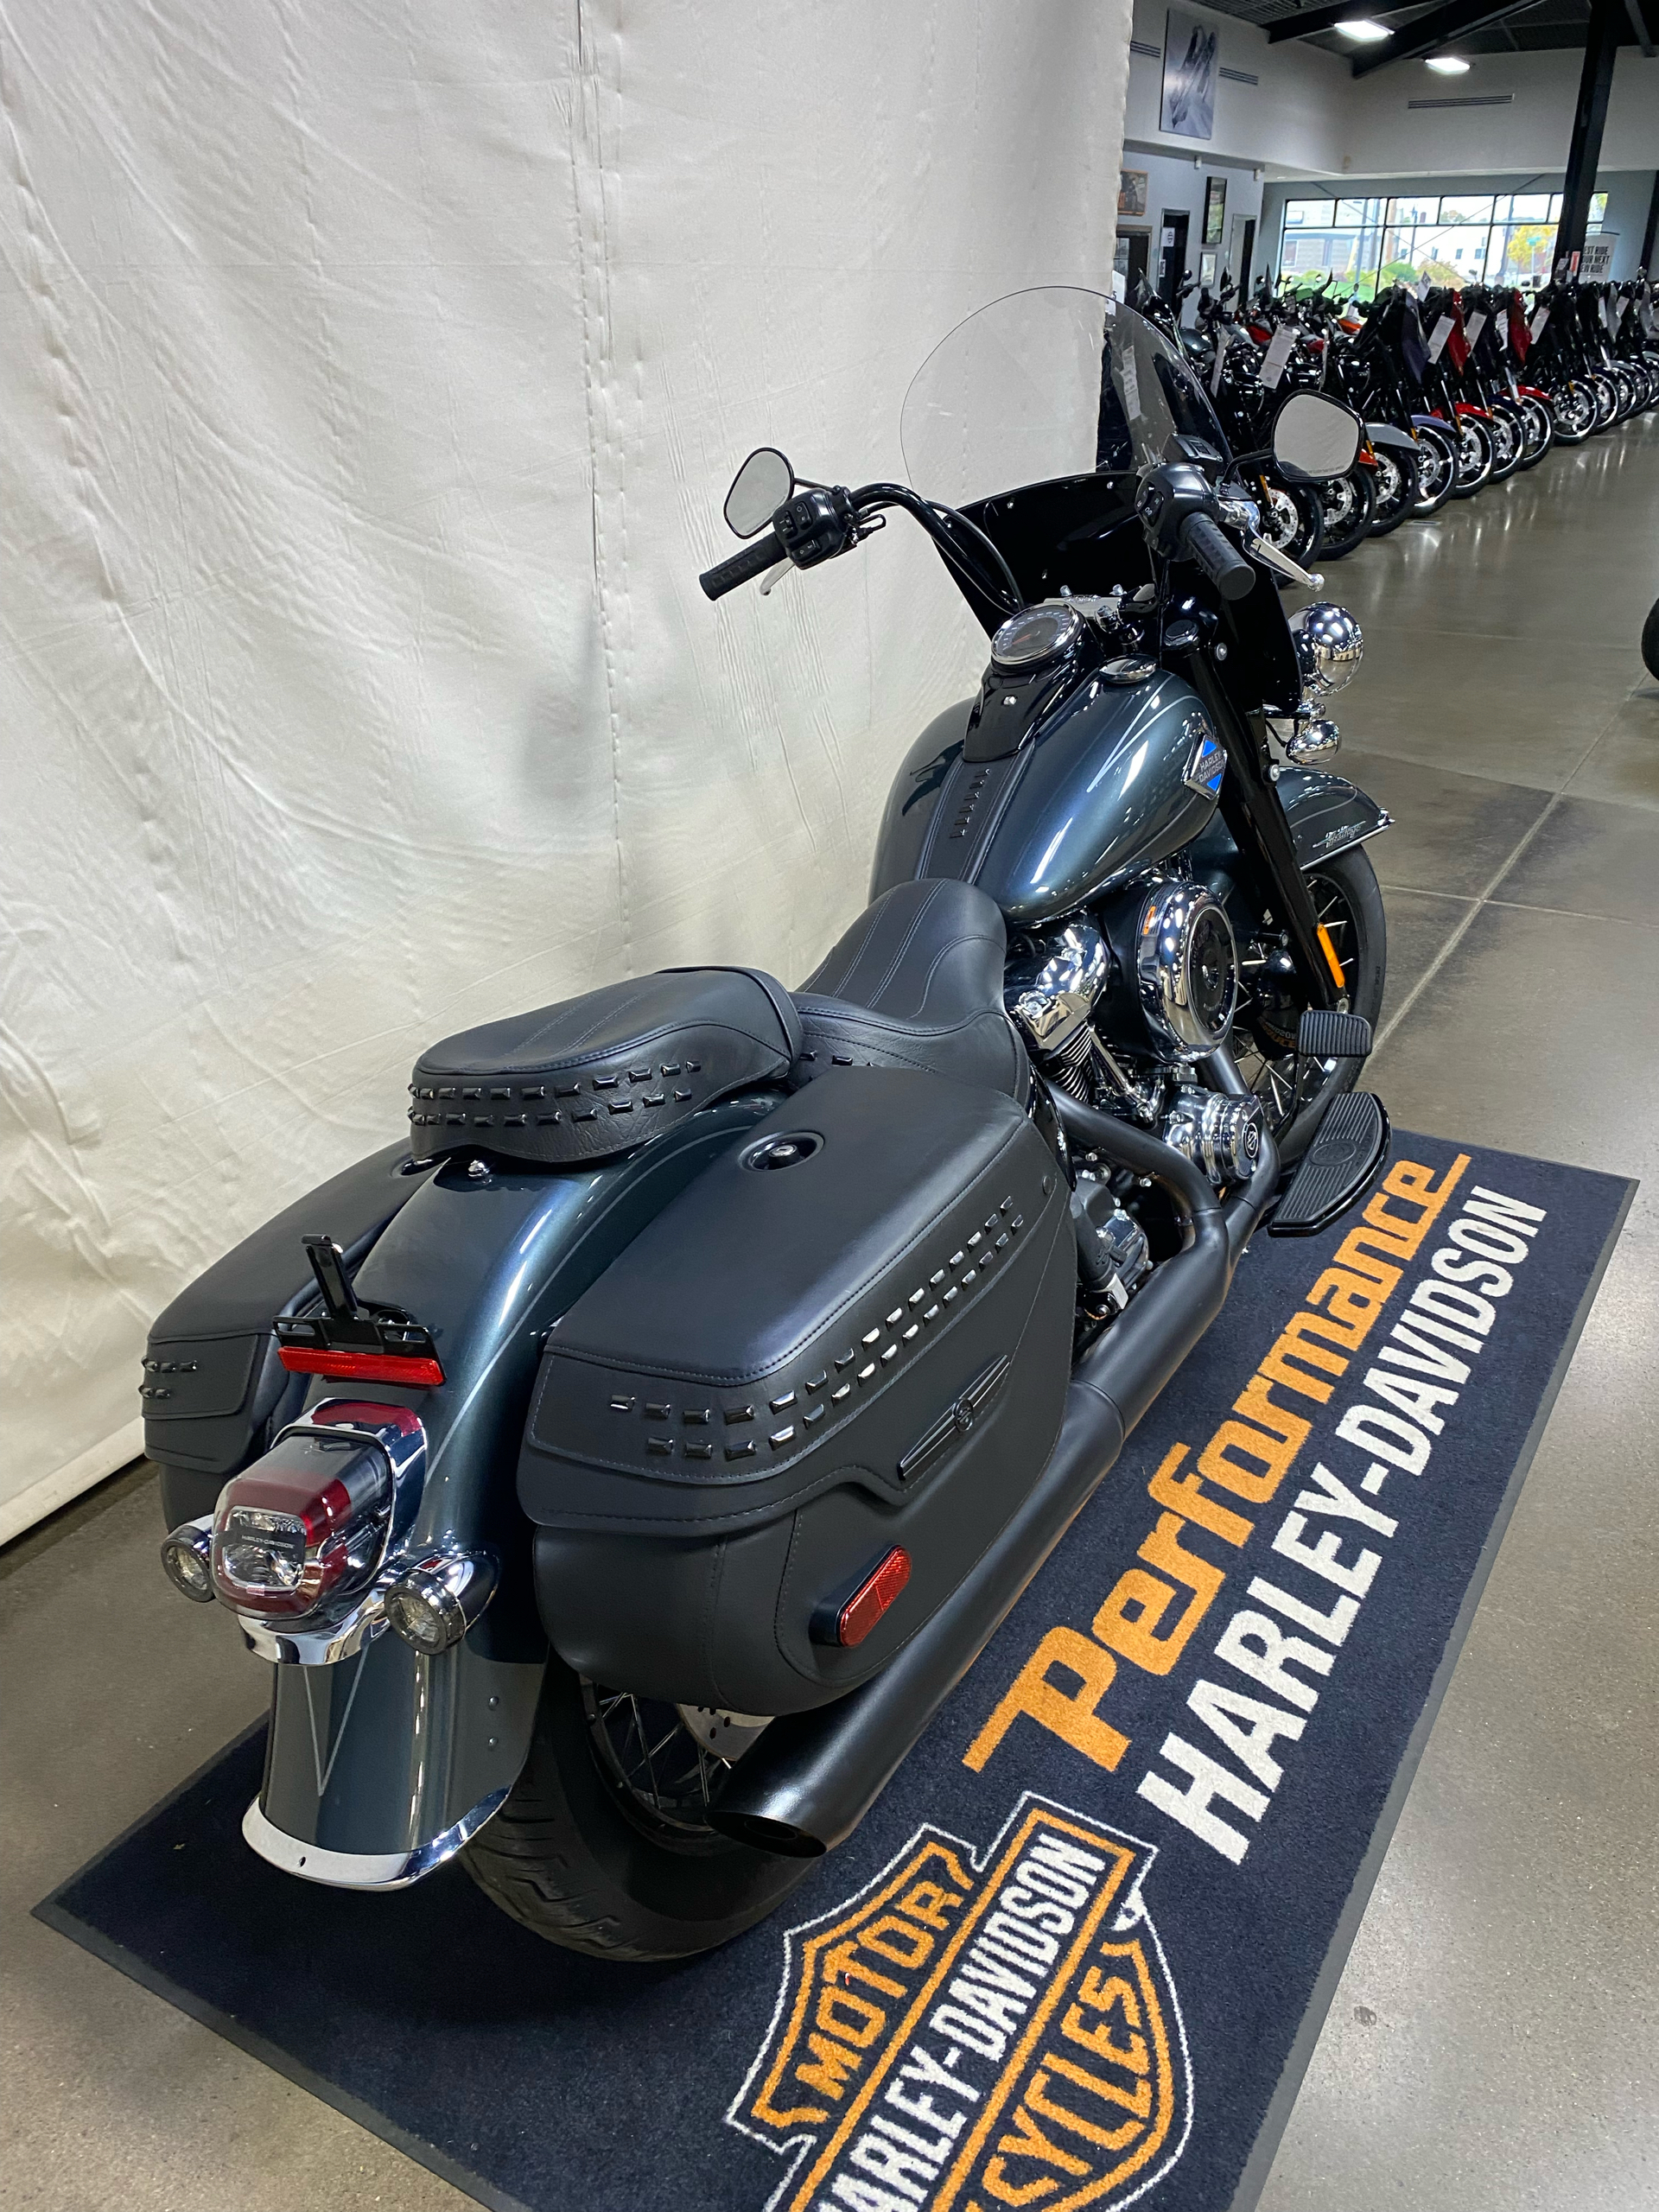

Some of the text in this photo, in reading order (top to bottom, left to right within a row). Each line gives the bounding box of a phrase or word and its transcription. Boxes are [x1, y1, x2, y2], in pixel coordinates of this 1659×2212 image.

[1584, 245, 1595, 254] EST
[962, 1153, 1471, 1773] Performance
[1135, 1185, 1548, 1866] HARLEY-DAVIDSON
[795, 1879, 964, 2101] MOTOR
[817, 1832, 1106, 2212] ARLEY-DAVIDSON
[982, 1966, 1153, 2207] CYCLES
